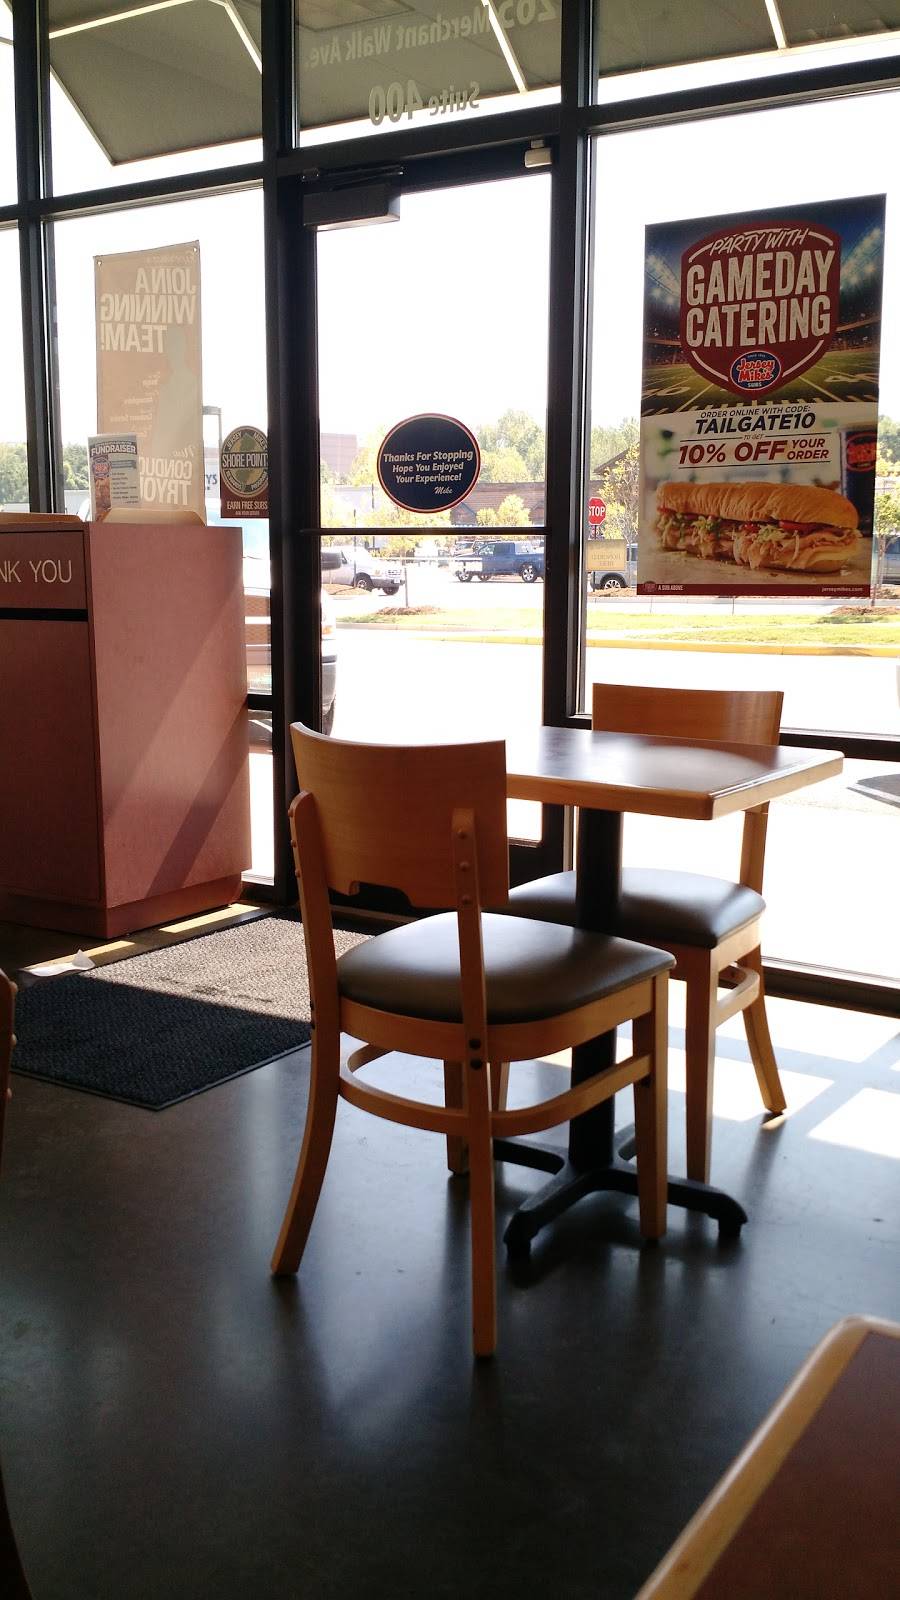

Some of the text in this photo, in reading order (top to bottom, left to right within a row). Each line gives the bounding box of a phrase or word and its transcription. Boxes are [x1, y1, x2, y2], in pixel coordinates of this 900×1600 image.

[710, 228, 809, 256] PARTY WITH
[686, 250, 835, 306] GAMEDAY
[686, 295, 831, 347] CATERING
[736, 358, 775, 371] Jersey
[700, 405, 811, 419] ORDER ONLINE WITH CODE:
[696, 412, 816, 435] TAILGATE10
[792, 438, 825, 449] YOUR
[91, 444, 137, 457] FUNDRAISER
[383, 449, 473, 462] Thanks For Stopping
[679, 439, 788, 465] 10% OFF
[787, 449, 829, 460] ORDER
[222, 453, 246, 468] SHORE
[392, 461, 464, 474] Hope You Enjoyed
[396, 473, 462, 484] Your Experience!
[434, 486, 453, 495] Mike
[226, 500, 268, 510] EARN FREE SUBS
[29, 559, 72, 583] YOU
